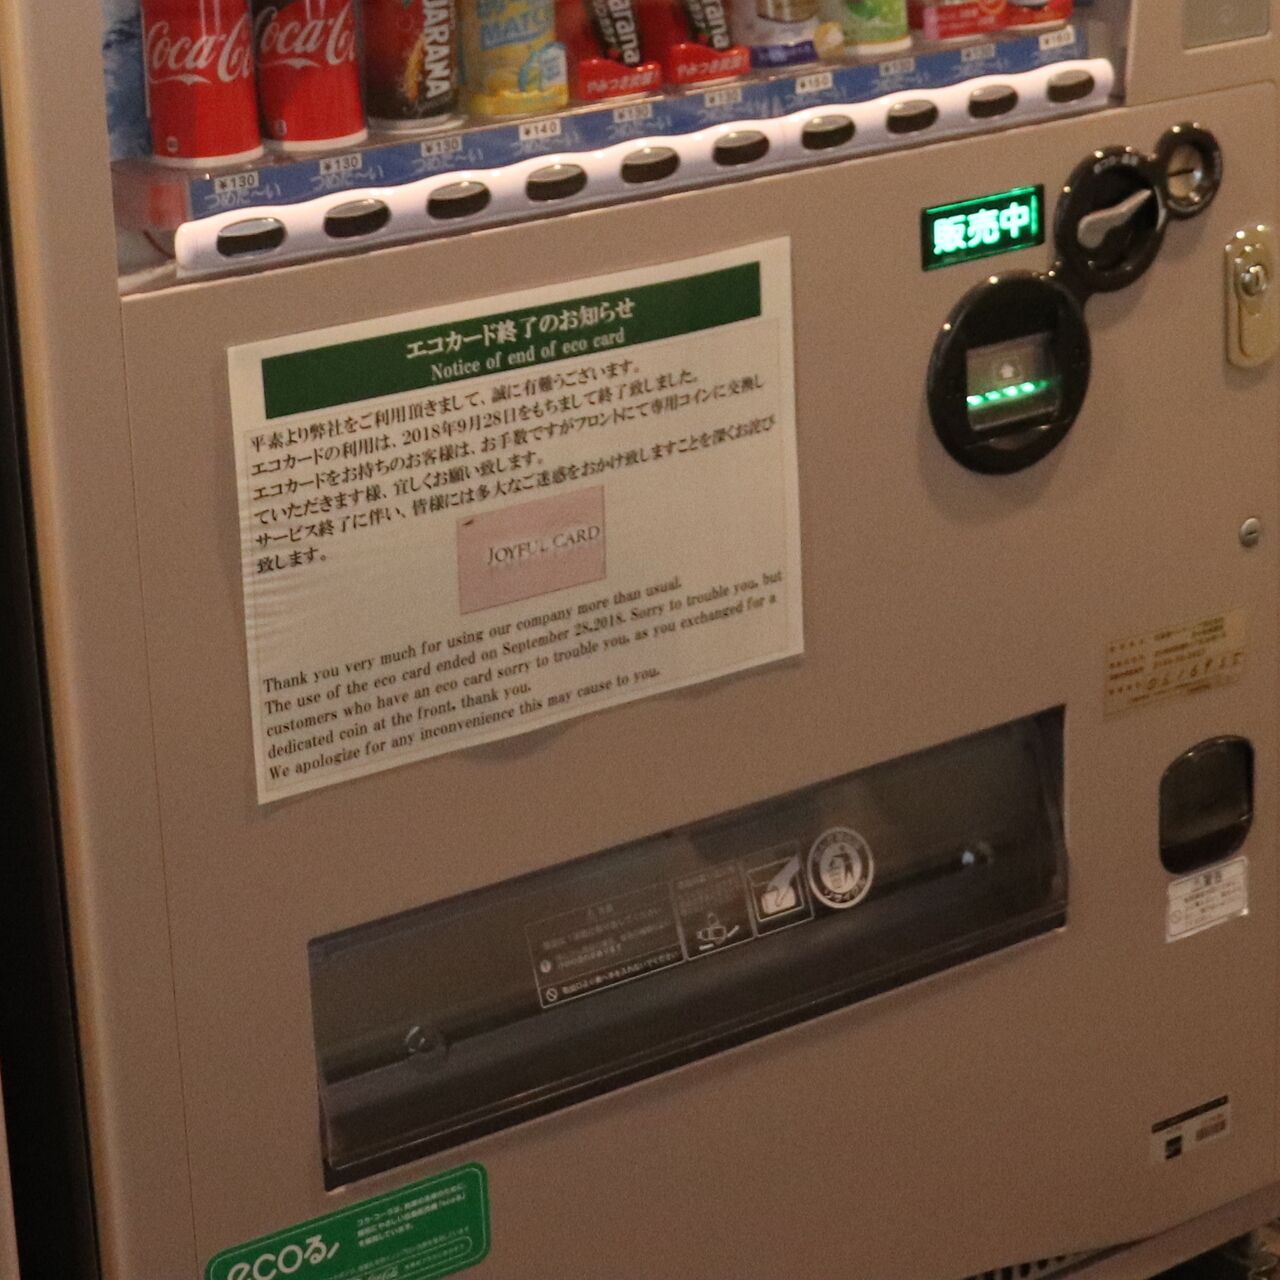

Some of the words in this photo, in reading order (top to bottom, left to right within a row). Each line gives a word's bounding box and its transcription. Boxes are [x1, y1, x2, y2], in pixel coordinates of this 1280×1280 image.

[932, 201, 1030, 256] 販売中
[406, 297, 635, 360] エコカード終了のお知らせ
[431, 357, 480, 381] Notice
[486, 352, 502, 369] of
[508, 345, 535, 365] end
[541, 341, 558, 359] of
[562, 338, 588, 353] eco
[593, 327, 625, 348] card
[257, 547, 328, 574] 致します。
[487, 537, 549, 566] JOYFUL
[553, 524, 601, 551] CARD
[263, 671, 308, 694] Thank
[314, 667, 340, 684] you
[345, 657, 374, 675] very
[380, 644, 417, 666] much
[421, 638, 443, 655] for
[447, 630, 483, 650] using
[489, 623, 512, 639] our
[517, 607, 573, 632] company
[577, 598, 609, 616] more
[613, 586, 641, 606] than
[265, 698, 292, 716] The
[297, 693, 321, 708] use
[327, 684, 342, 700] of
[347, 678, 368, 695] the
[374, 674, 397, 689] eco
[402, 660, 431, 682] card
[437, 650, 476, 673] ended
[481, 647, 498, 662] on
[503, 628, 570, 657] September
[266, 710, 338, 738] customers
[343, 700, 372, 718] who
[376, 692, 410, 710] have
[415, 686, 431, 700] an
[435, 679, 458, 694] eco
[463, 667, 492, 687] card
[497, 661, 530, 679] sorry
[536, 654, 549, 669] to
[553, 640, 599, 664] trouble
[268, 730, 335, 760] dedicated
[339, 723, 368, 743] coin
[373, 718, 387, 732] at
[391, 711, 413, 727] the
[461, 688, 499, 709] thank
[269, 764, 290, 781] We
[295, 748, 360, 774] apologize
[365, 739, 387, 757] for
[391, 733, 414, 750] any
[420, 708, 515, 740] inconvenience
[519, 698, 543, 715] this
[547, 691, 573, 708] may
[577, 680, 612, 698] cause
[616, 673, 630, 687] to
